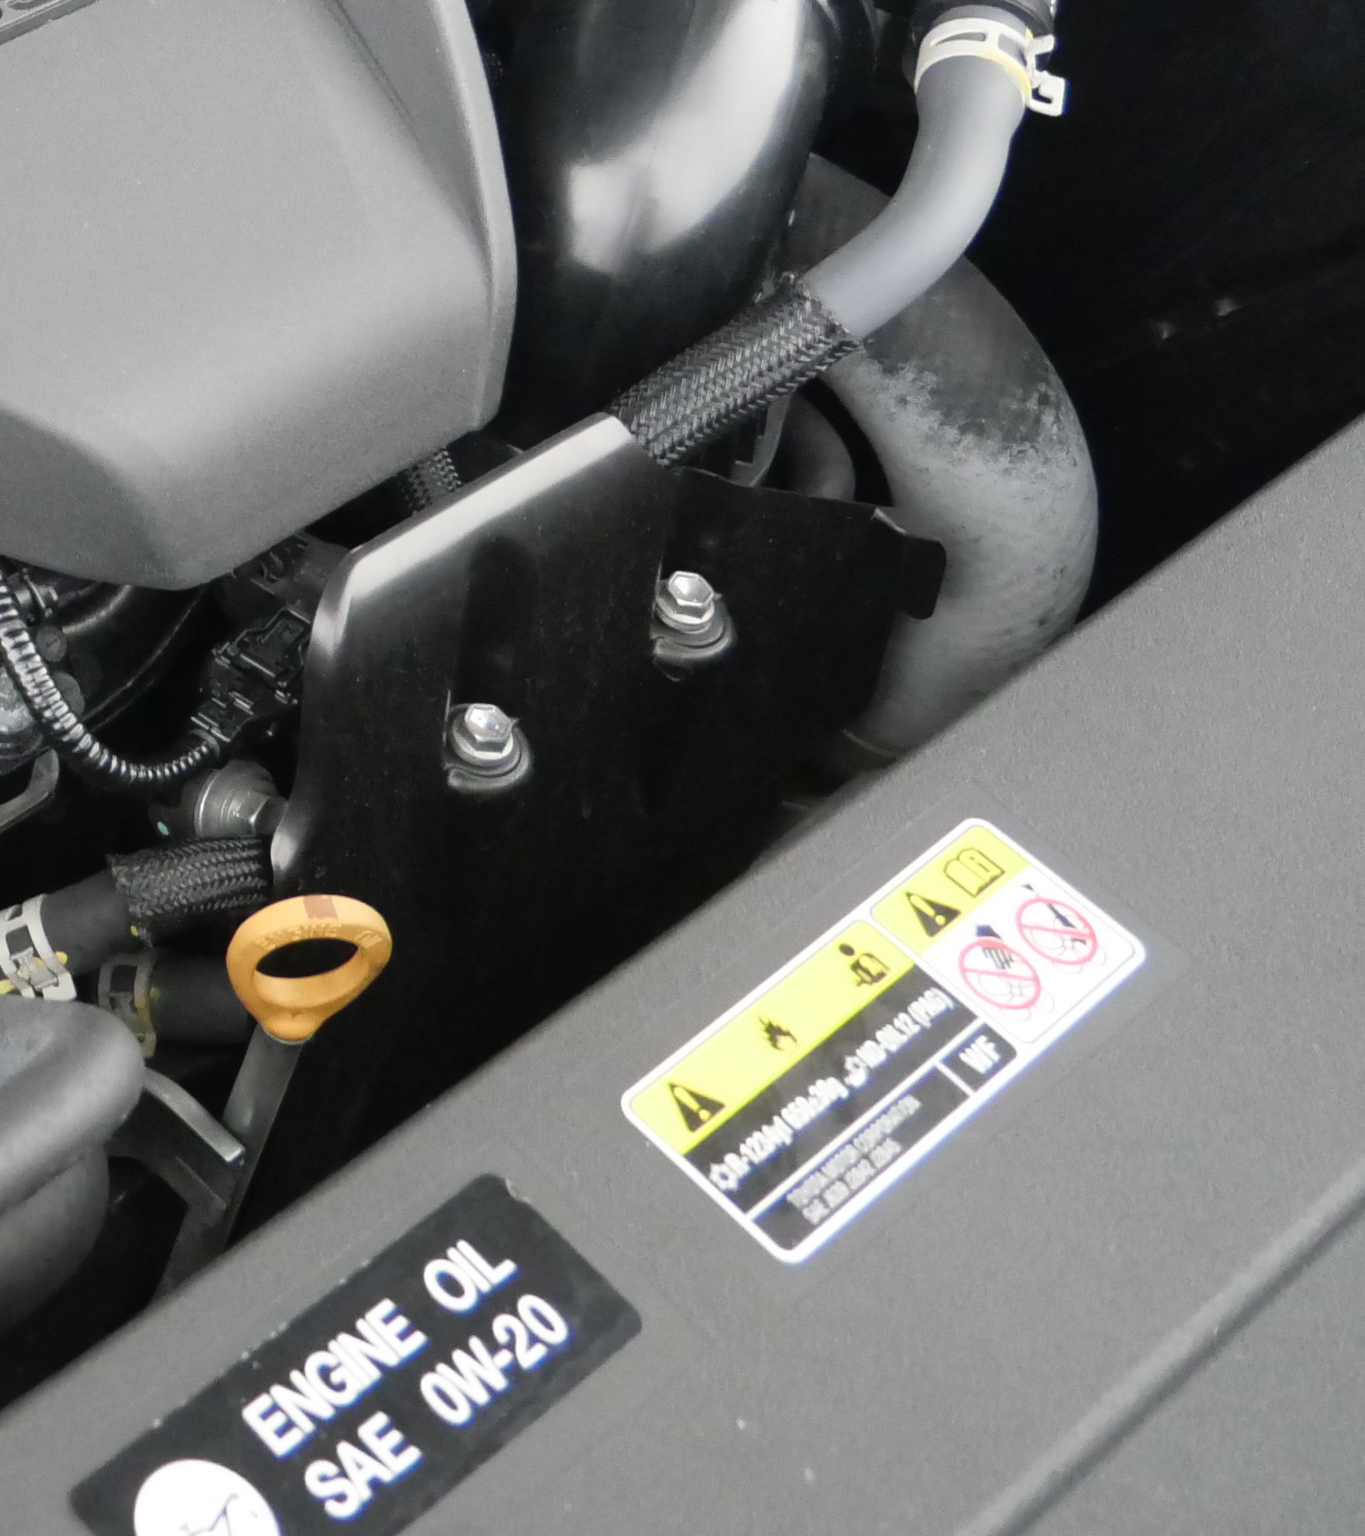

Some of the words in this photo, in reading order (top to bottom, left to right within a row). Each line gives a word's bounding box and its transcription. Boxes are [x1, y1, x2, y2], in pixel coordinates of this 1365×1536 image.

[959, 1035, 1001, 1074] WF
[242, 1298, 428, 1459] ENGINE
[422, 1239, 518, 1313] OIL
[304, 1411, 424, 1520] SAE
[419, 1293, 570, 1427] 0W-20
